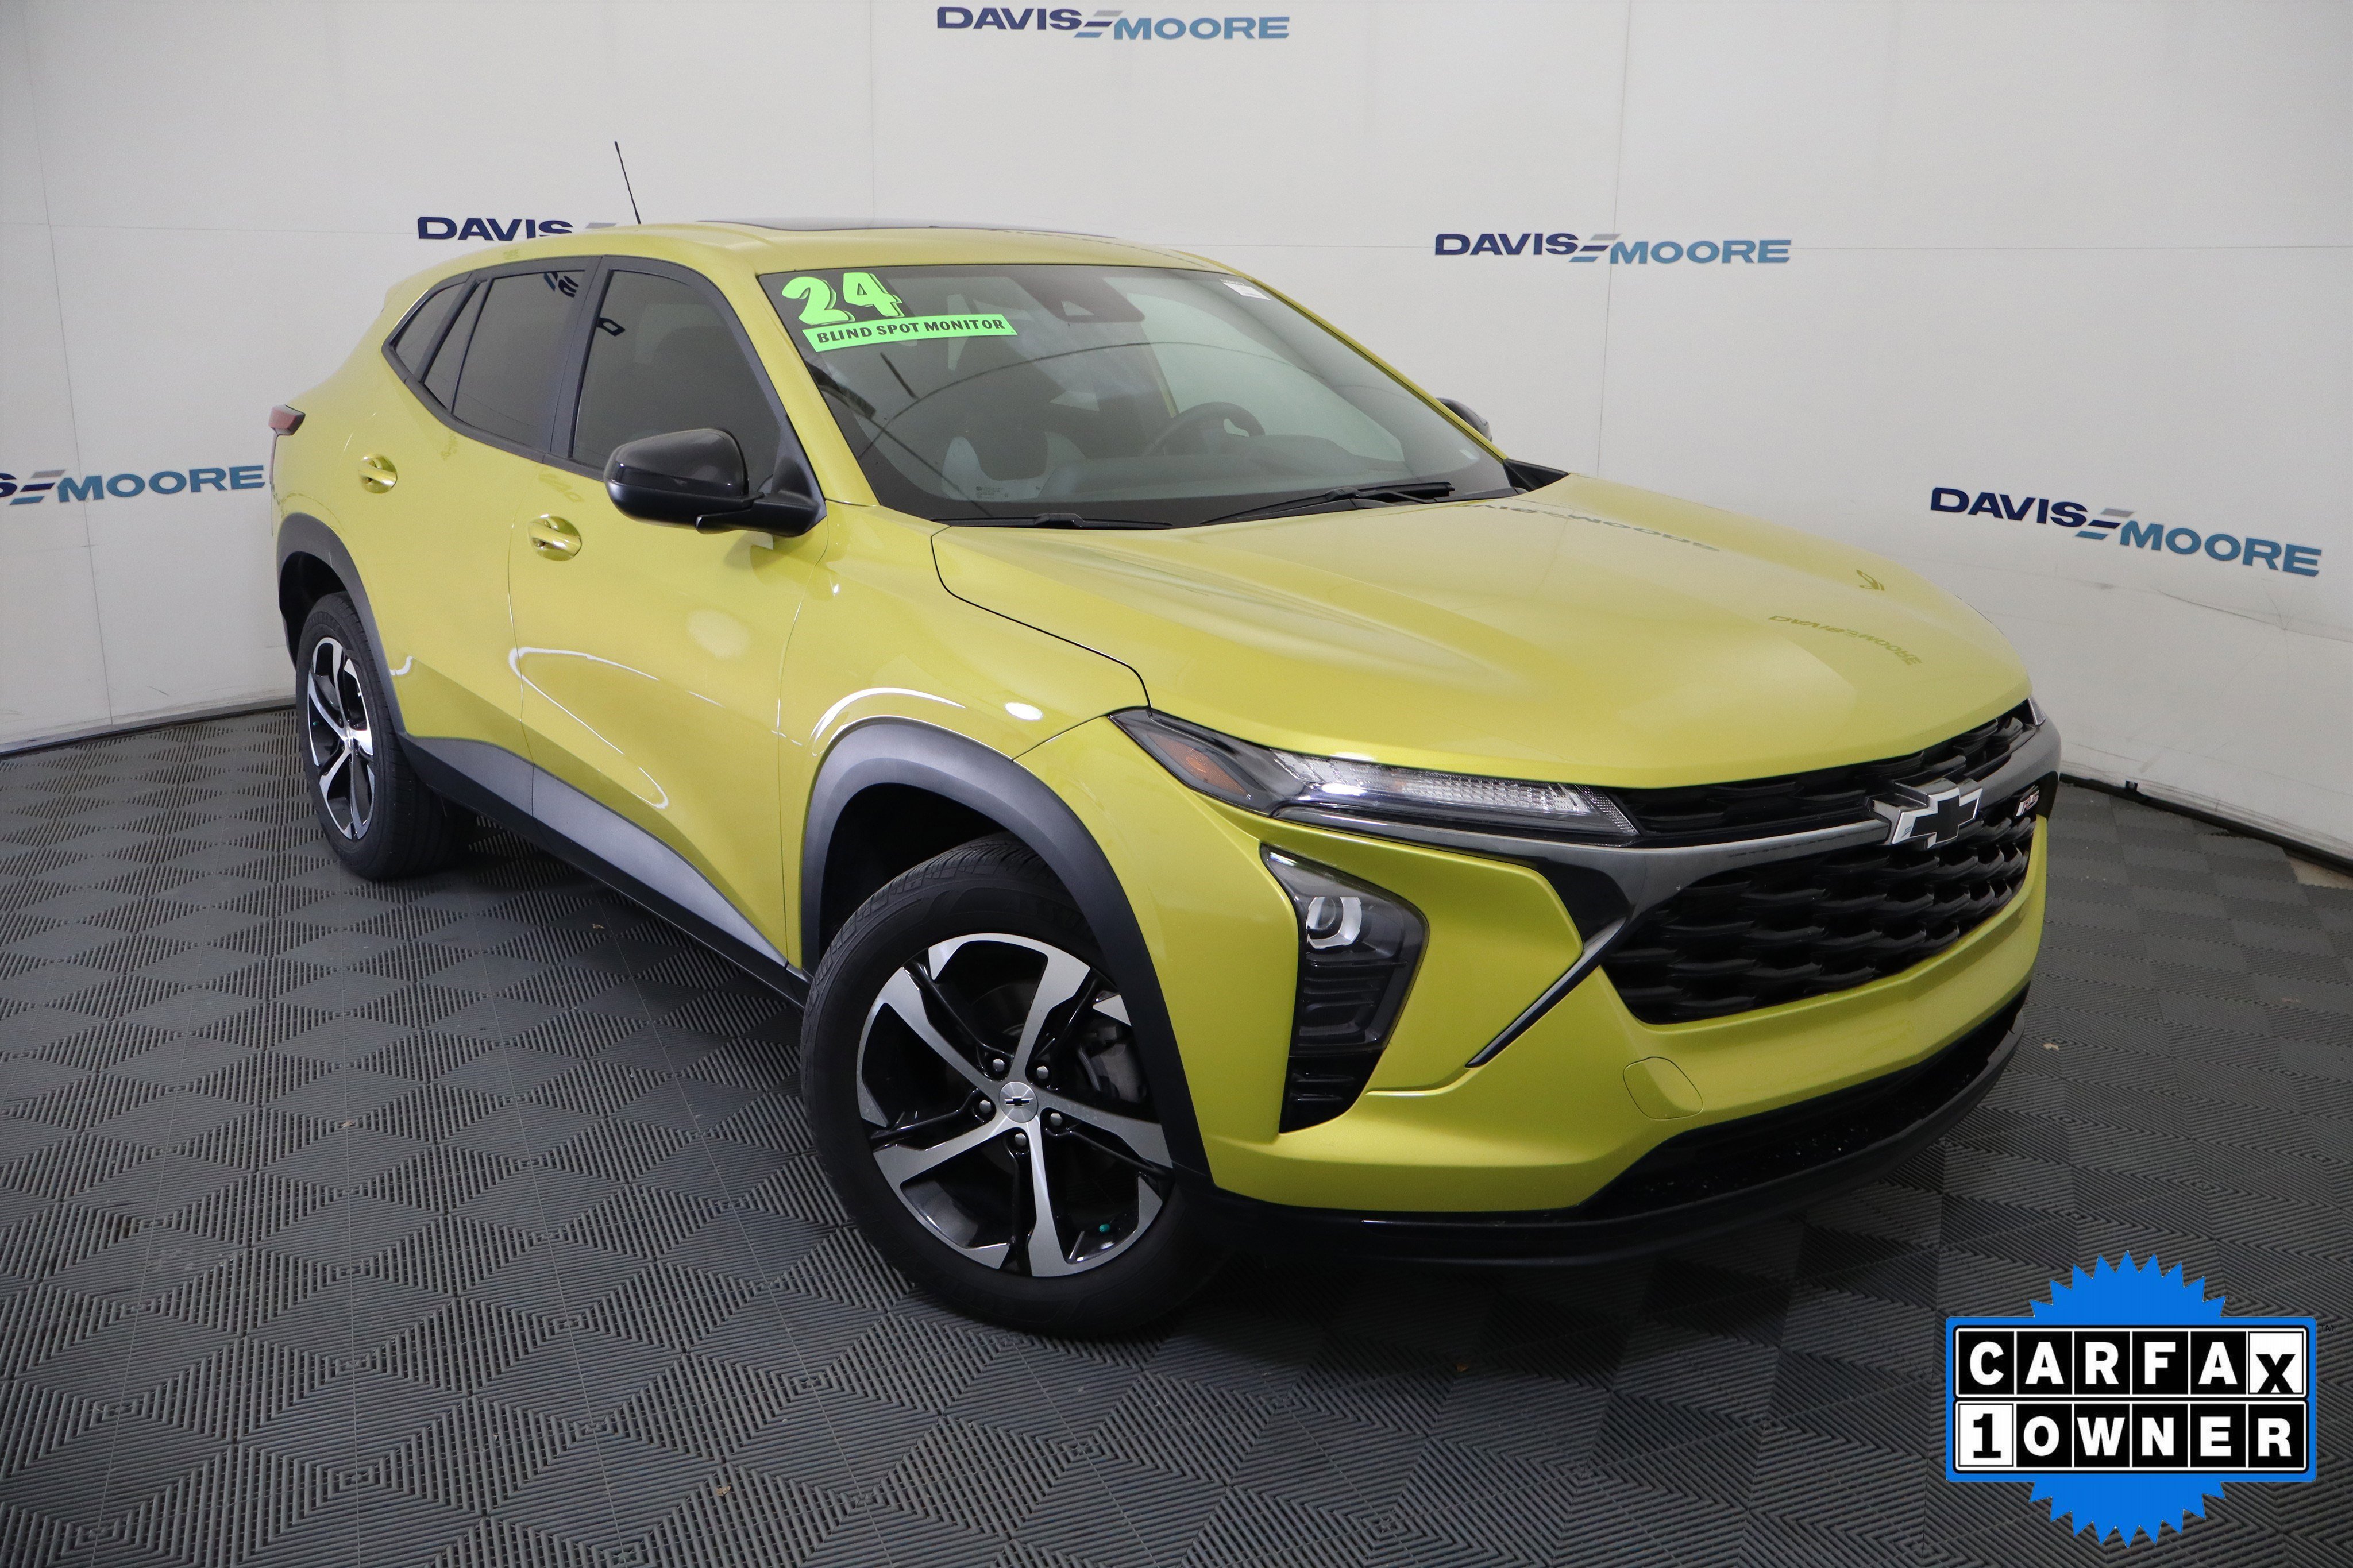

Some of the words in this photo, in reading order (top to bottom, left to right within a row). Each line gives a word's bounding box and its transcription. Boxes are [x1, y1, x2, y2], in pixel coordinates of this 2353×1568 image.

[937, 6, 1082, 31] DAVIS
[1114, 16, 1290, 40] MOORE
[418, 216, 573, 241] DAVIS
[1434, 233, 1579, 256] DAVIS
[1610, 239, 1792, 264] MOORE
[782, 272, 905, 326] 24
[817, 326, 873, 343] BLIND
[877, 322, 919, 335] SPOT
[925, 319, 1006, 333] MONITOR
[57, 465, 265, 503] MOORE
[1930, 486, 2088, 528] DAVIS
[2119, 520, 2323, 577] MOORE
